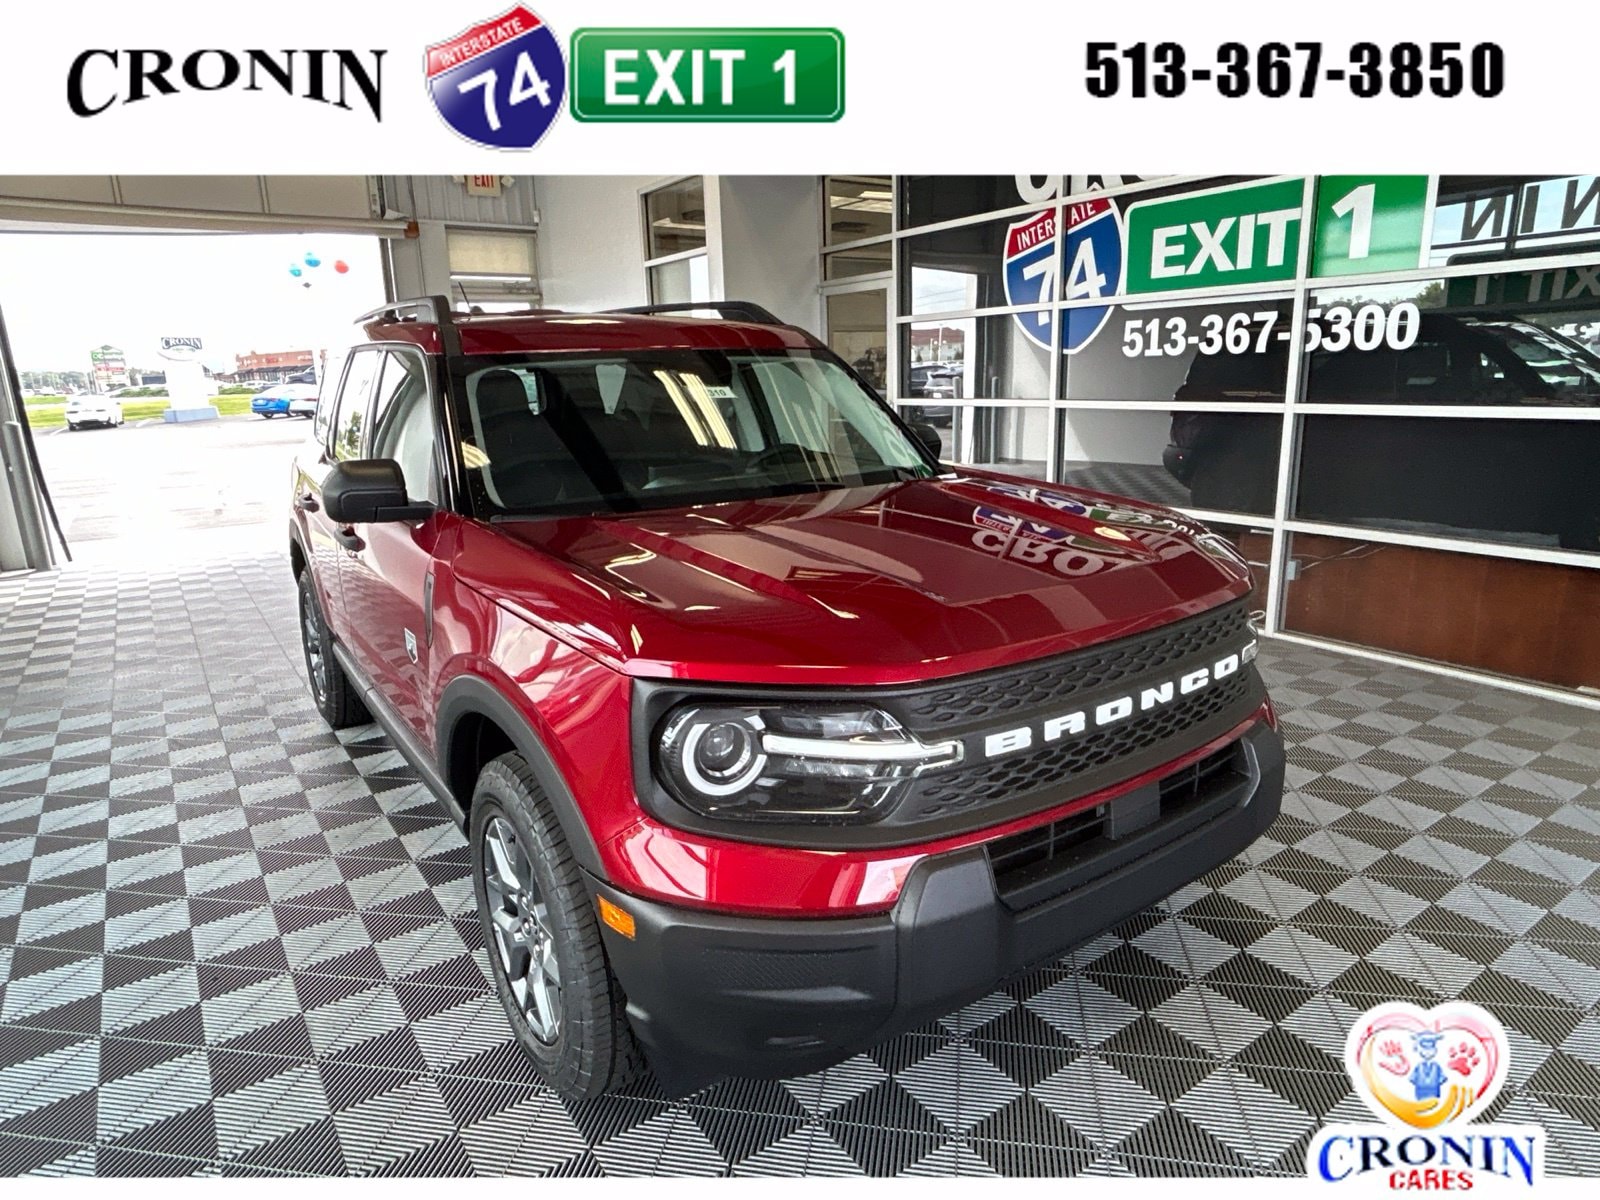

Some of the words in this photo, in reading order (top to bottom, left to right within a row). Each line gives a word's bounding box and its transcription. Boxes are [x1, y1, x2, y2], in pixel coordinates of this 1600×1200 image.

[1016, 201, 1097, 251] INTERATE
[1150, 206, 1302, 280] EXIT
[1331, 183, 1376, 260] 1
[1022, 237, 1107, 327] 74
[161, 337, 202, 350] CRONIN
[1121, 302, 1421, 358] 513-367-5300
[984, 653, 1239, 758] BRONCO
